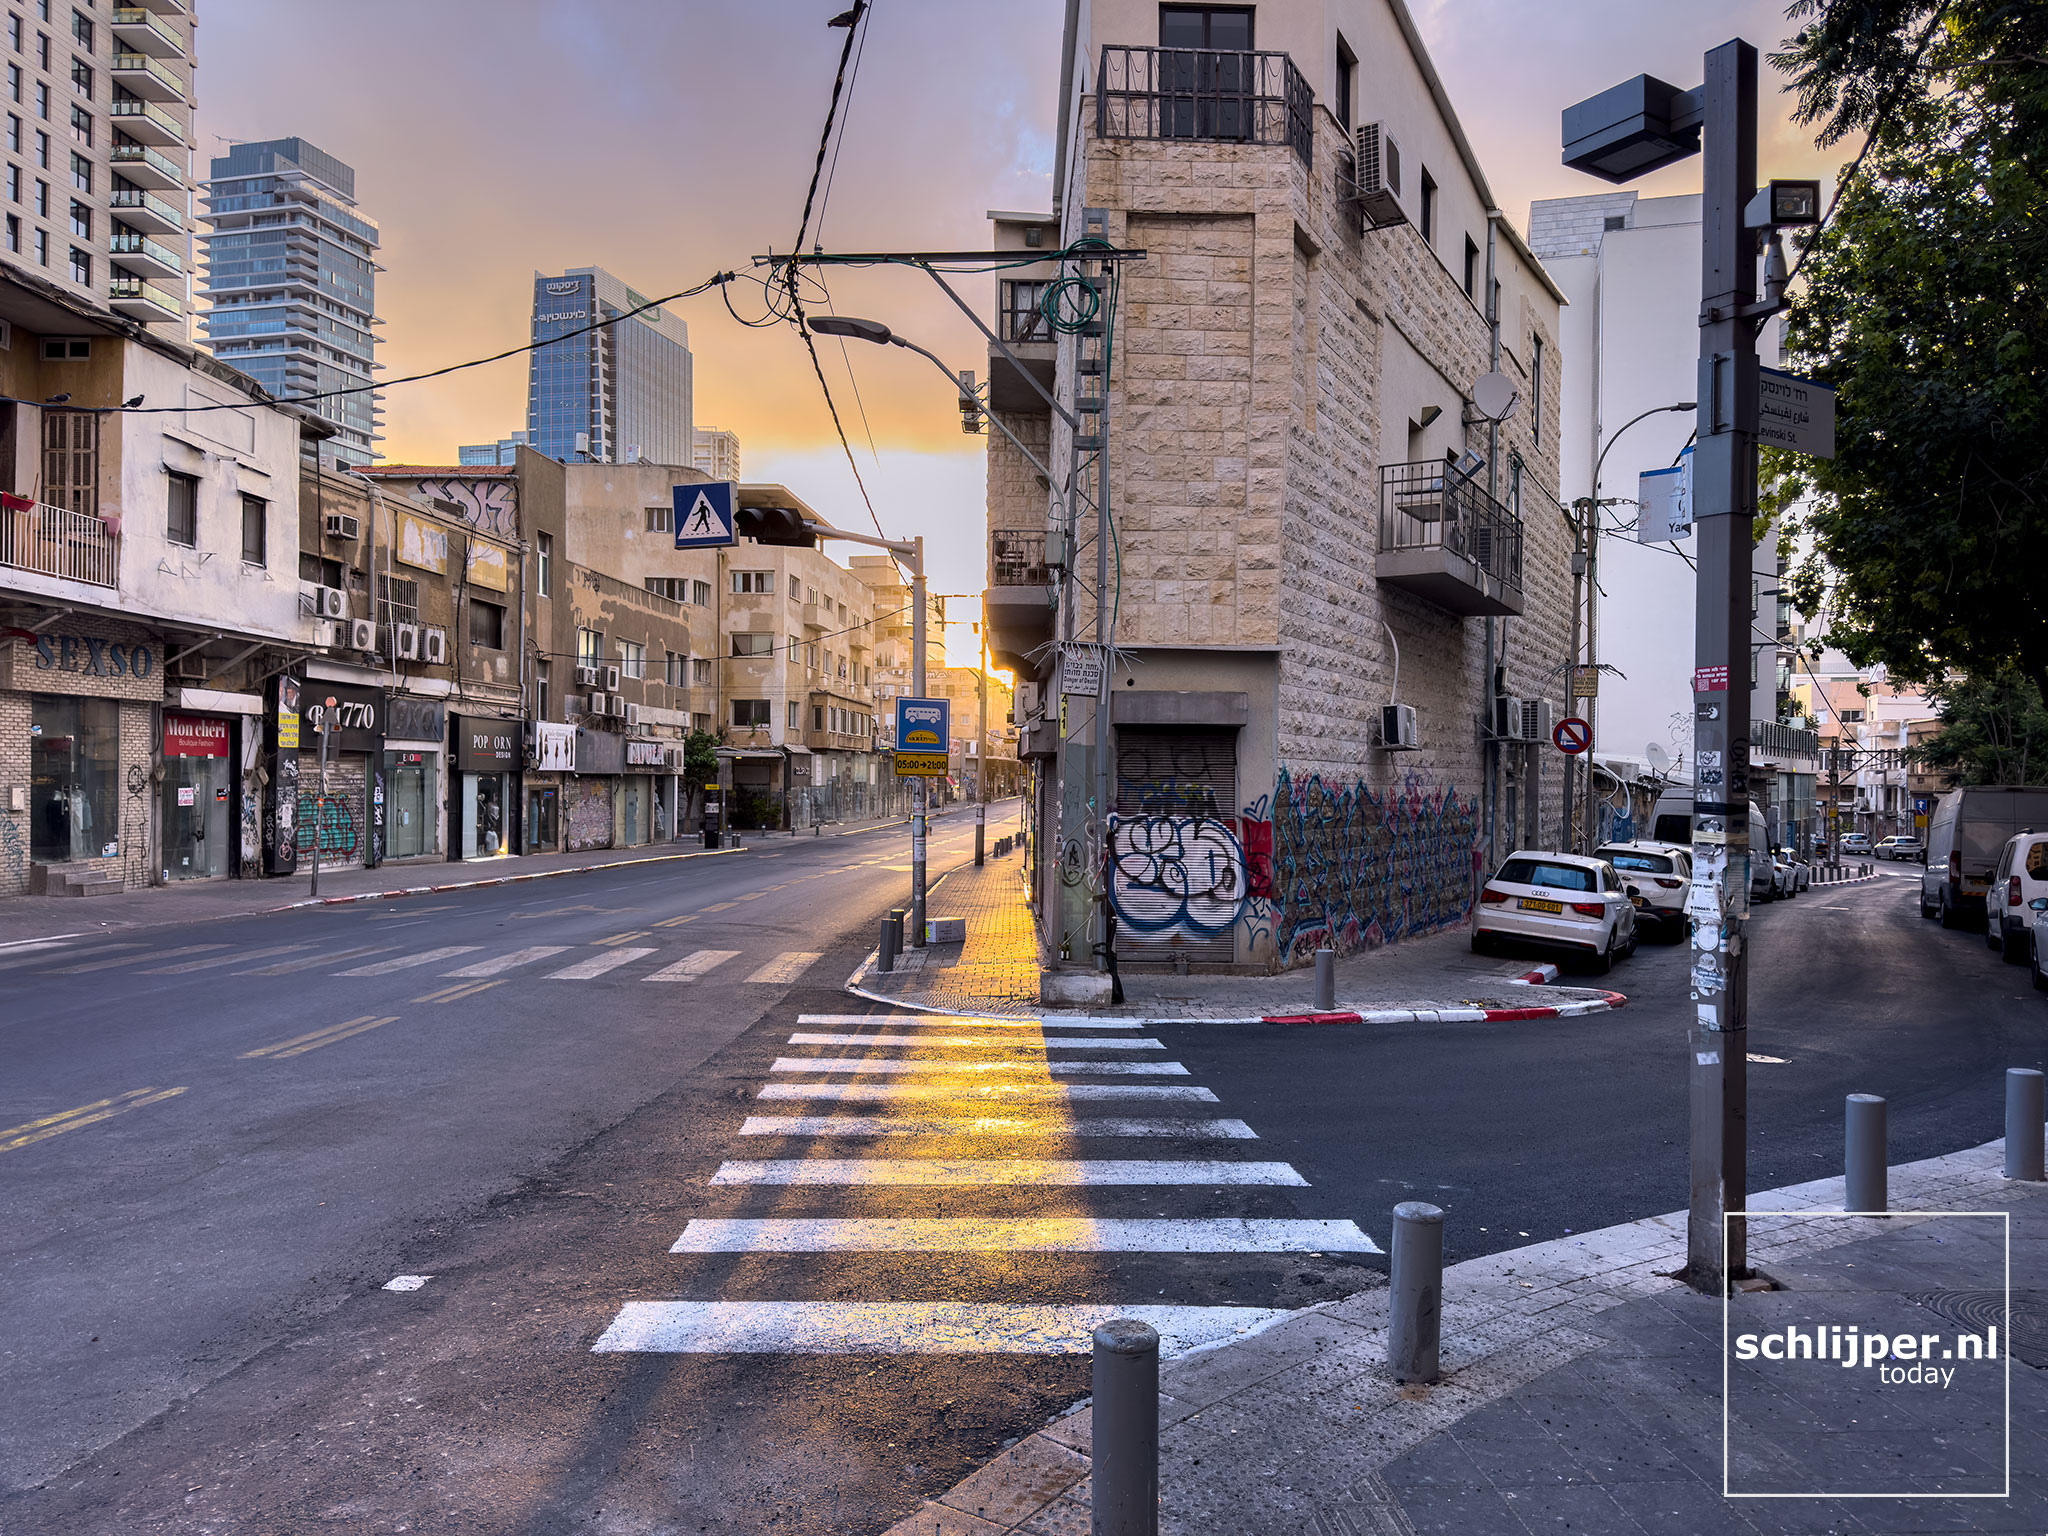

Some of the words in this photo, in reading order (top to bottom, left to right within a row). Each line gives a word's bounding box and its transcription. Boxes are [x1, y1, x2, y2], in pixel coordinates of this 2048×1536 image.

[546, 281, 580, 291] דיסקונט
[1760, 380, 1792, 397] לוינסק
[1759, 427, 1787, 440] evinski
[36, 634, 152, 678] SEXSO
[1063, 676, 1079, 684] Danger
[166, 718, 193, 736] Mon
[195, 719, 225, 738] chéri
[178, 739, 198, 747] Boutique
[198, 739, 214, 747] Fashion
[495, 751, 511, 759] DESIGN
[897, 760, 919, 769] 05:00
[927, 760, 946, 769] 21:00
